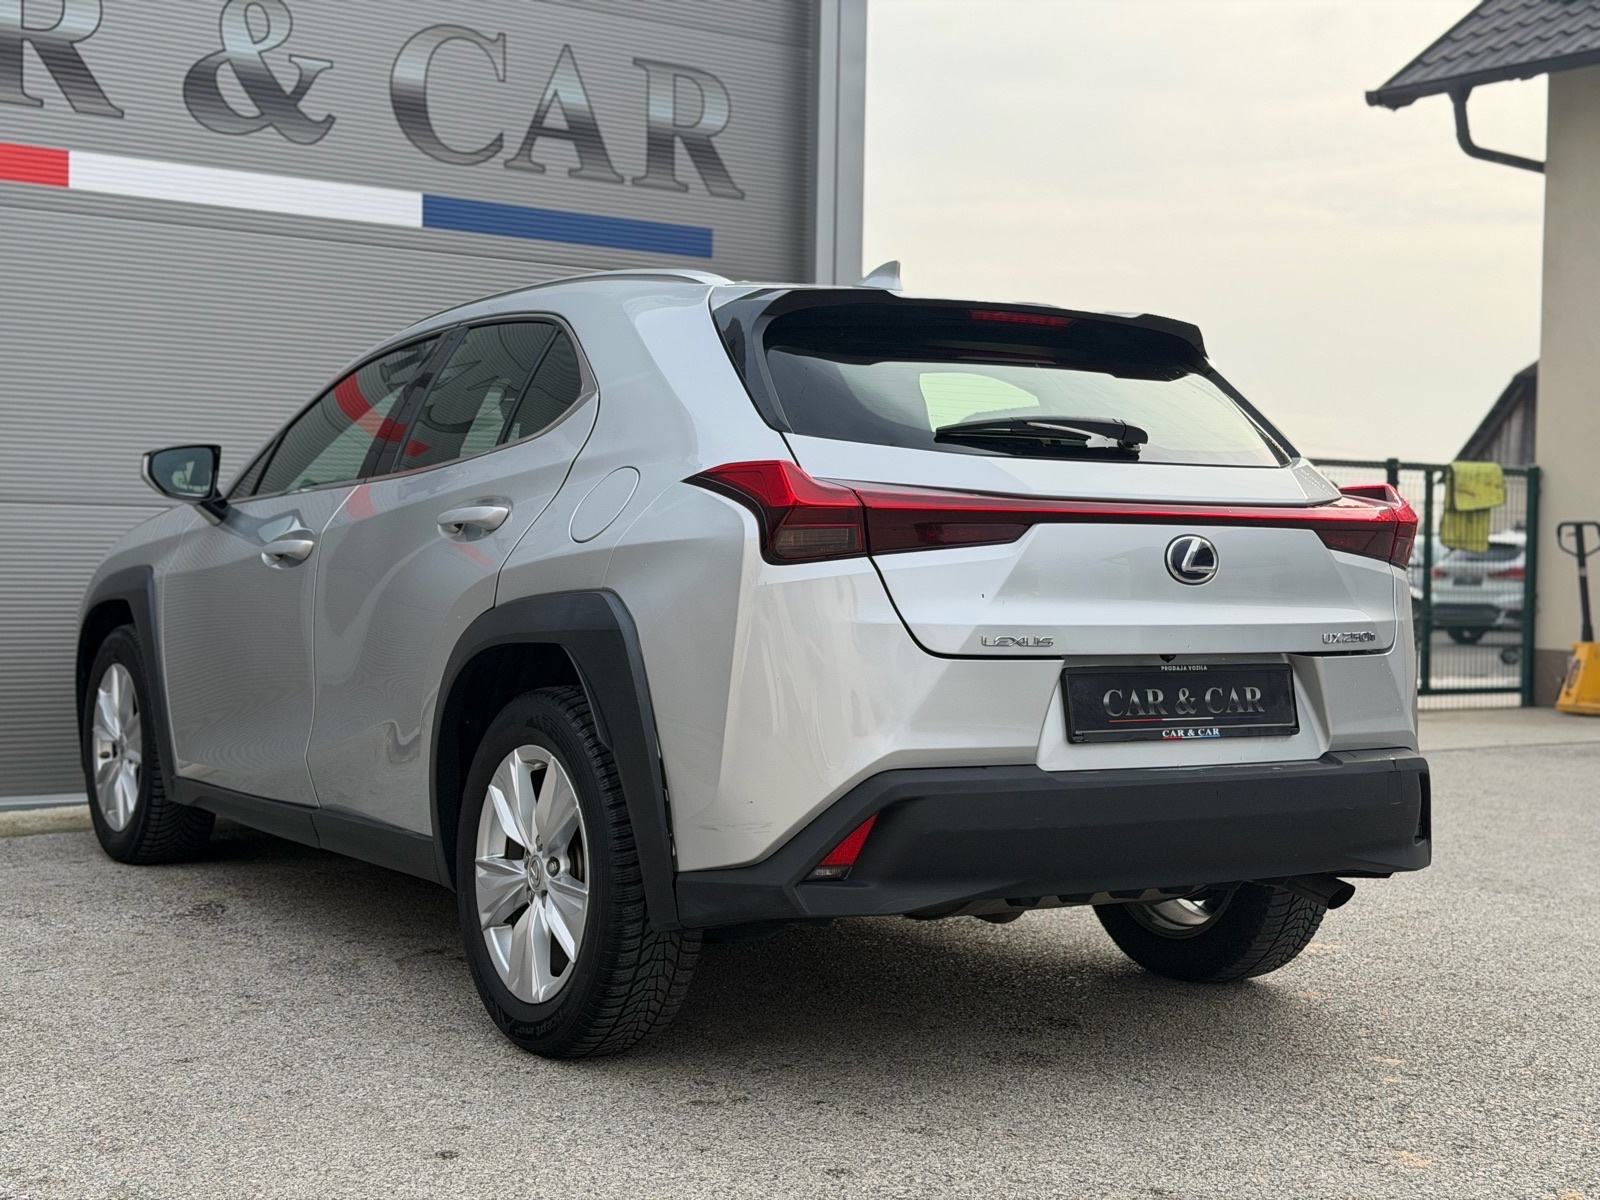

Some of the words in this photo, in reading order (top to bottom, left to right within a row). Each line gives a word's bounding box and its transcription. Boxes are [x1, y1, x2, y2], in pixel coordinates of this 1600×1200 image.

[183, 0, 336, 145] &
[389, 23, 746, 201] CAR
[980, 635, 1054, 648] LEXUS
[1103, 688, 1168, 717] CAR
[1175, 687, 1197, 715] &
[1204, 686, 1265, 714] CAR
[1162, 729, 1185, 737] CAR
[1198, 728, 1220, 736] CAR
